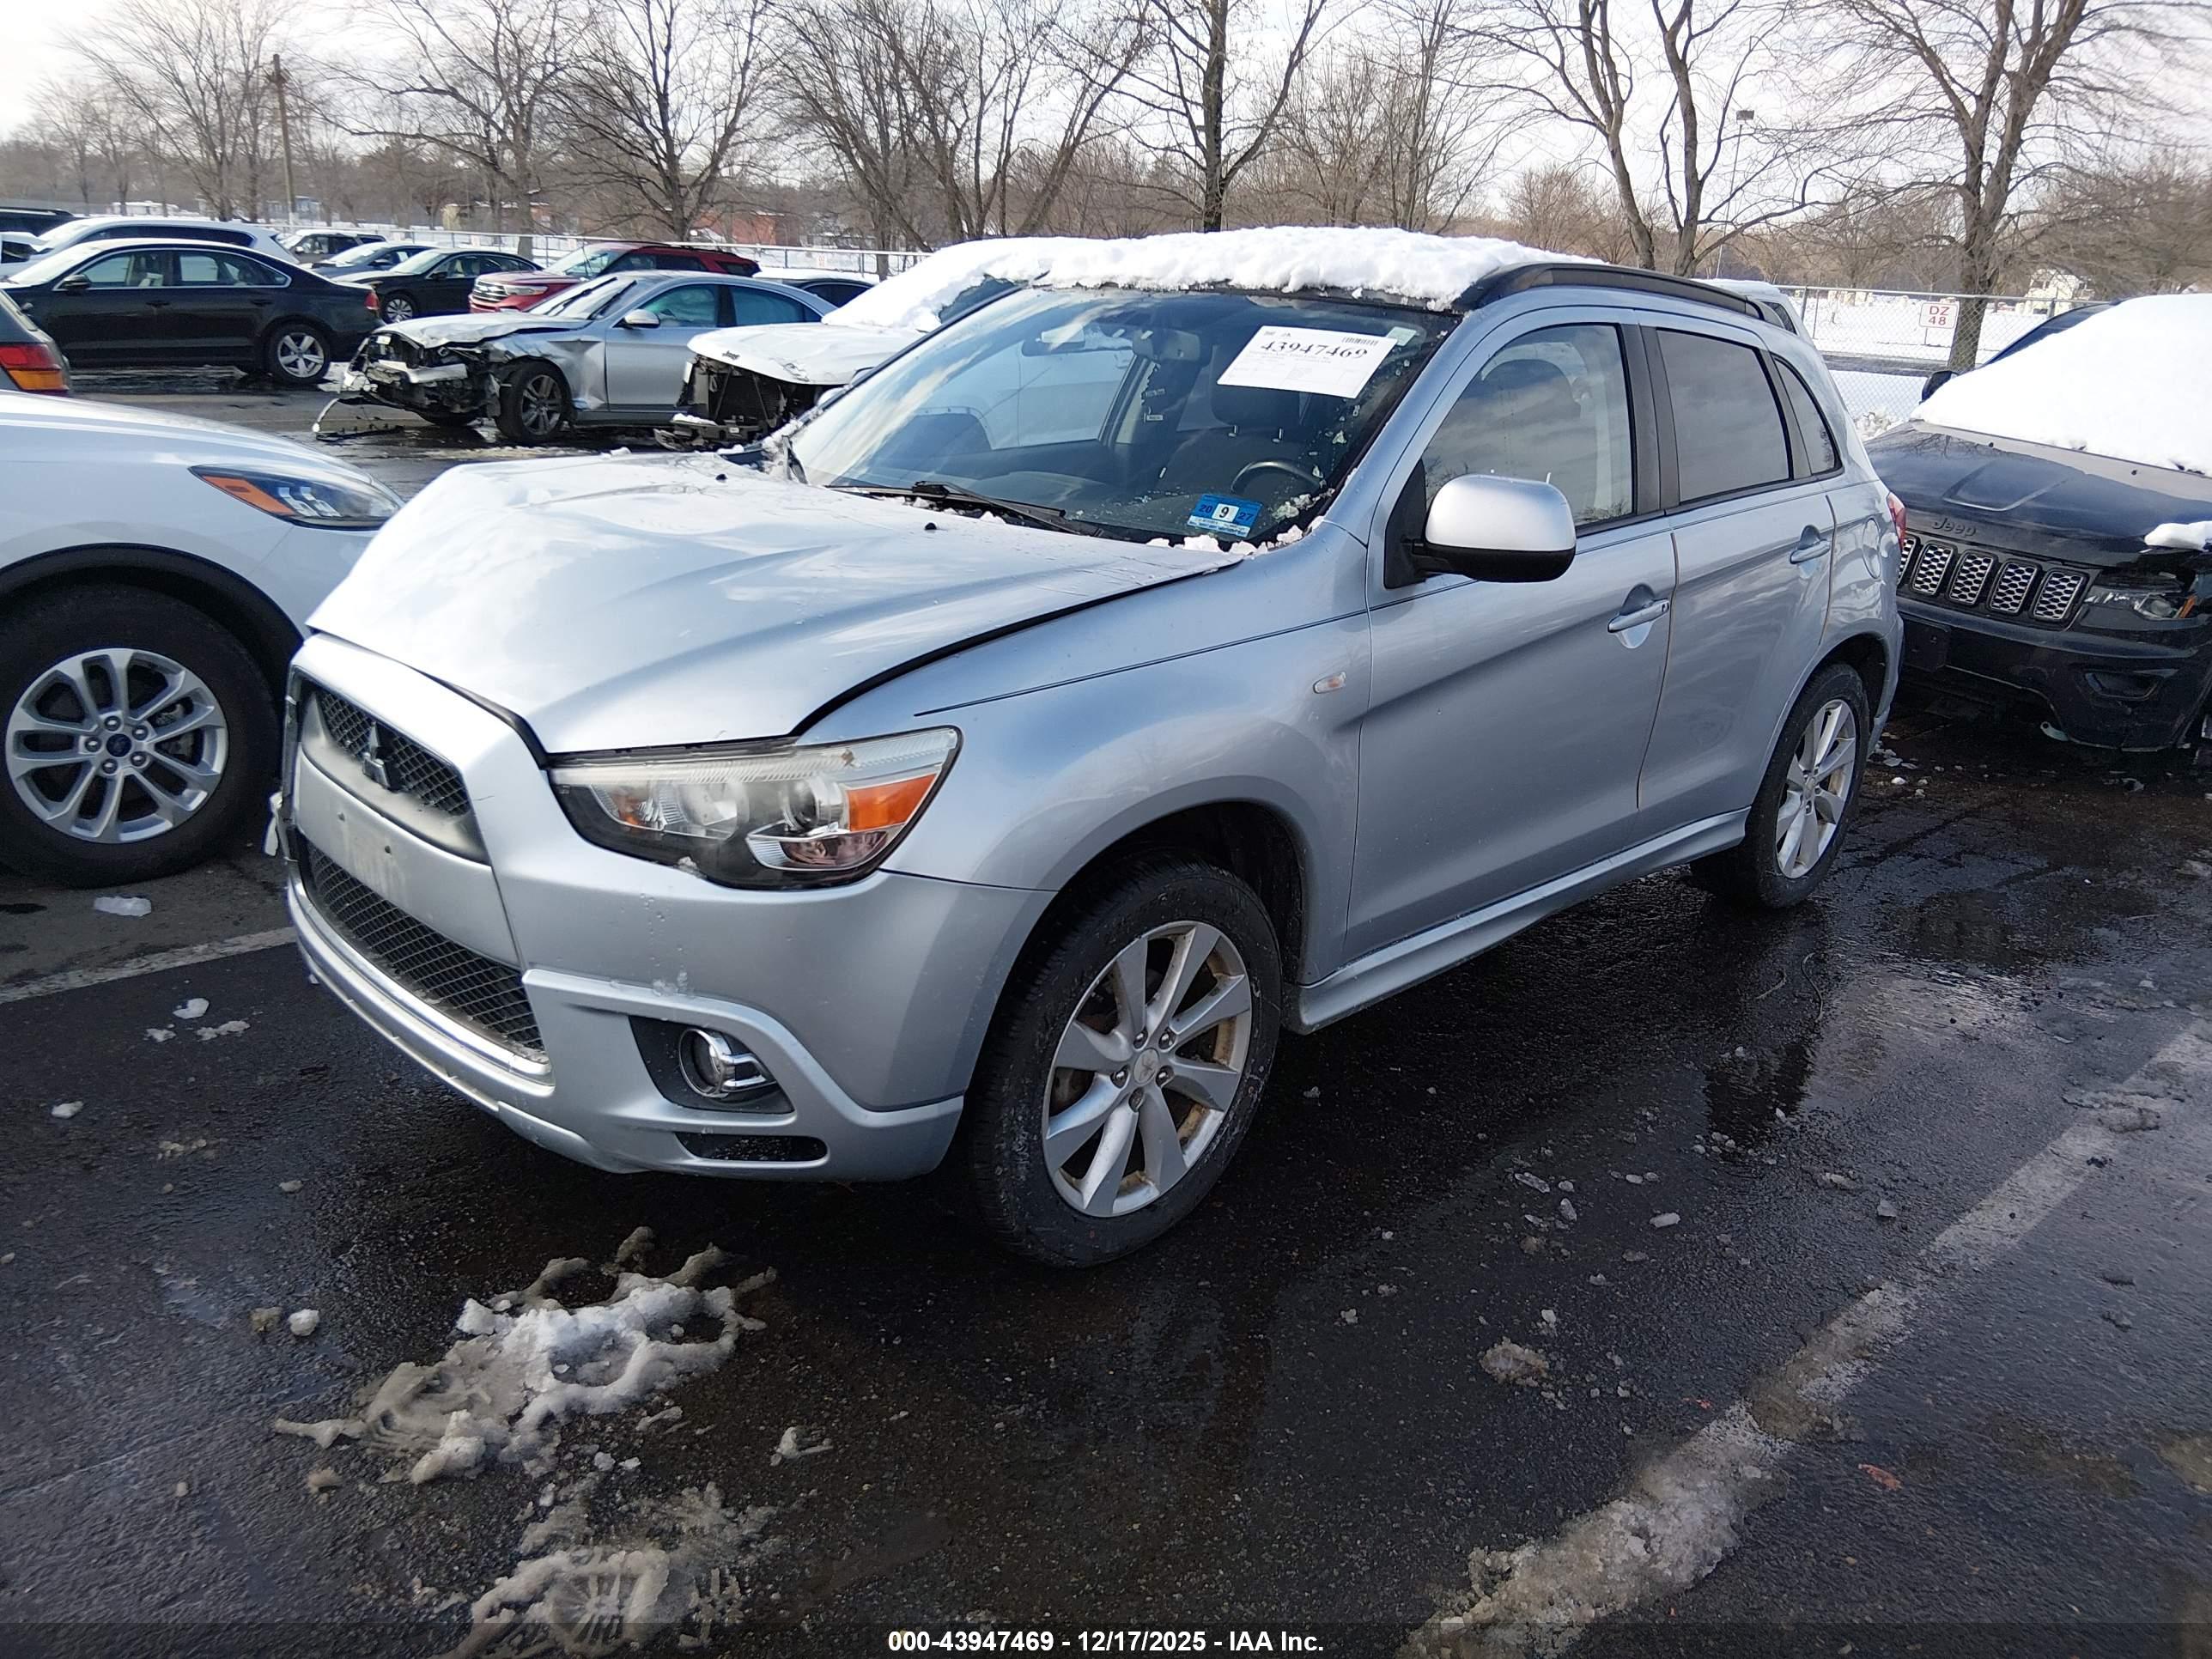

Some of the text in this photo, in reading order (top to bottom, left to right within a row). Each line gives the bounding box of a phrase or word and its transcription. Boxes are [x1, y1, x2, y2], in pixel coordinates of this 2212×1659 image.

[1929, 306, 1950, 316] DZ
[1928, 316, 1947, 325] 48
[1261, 340, 1369, 359] 43947469
[1199, 504, 1255, 521] 20 9 27
[1932, 517, 1978, 538] Jeep
